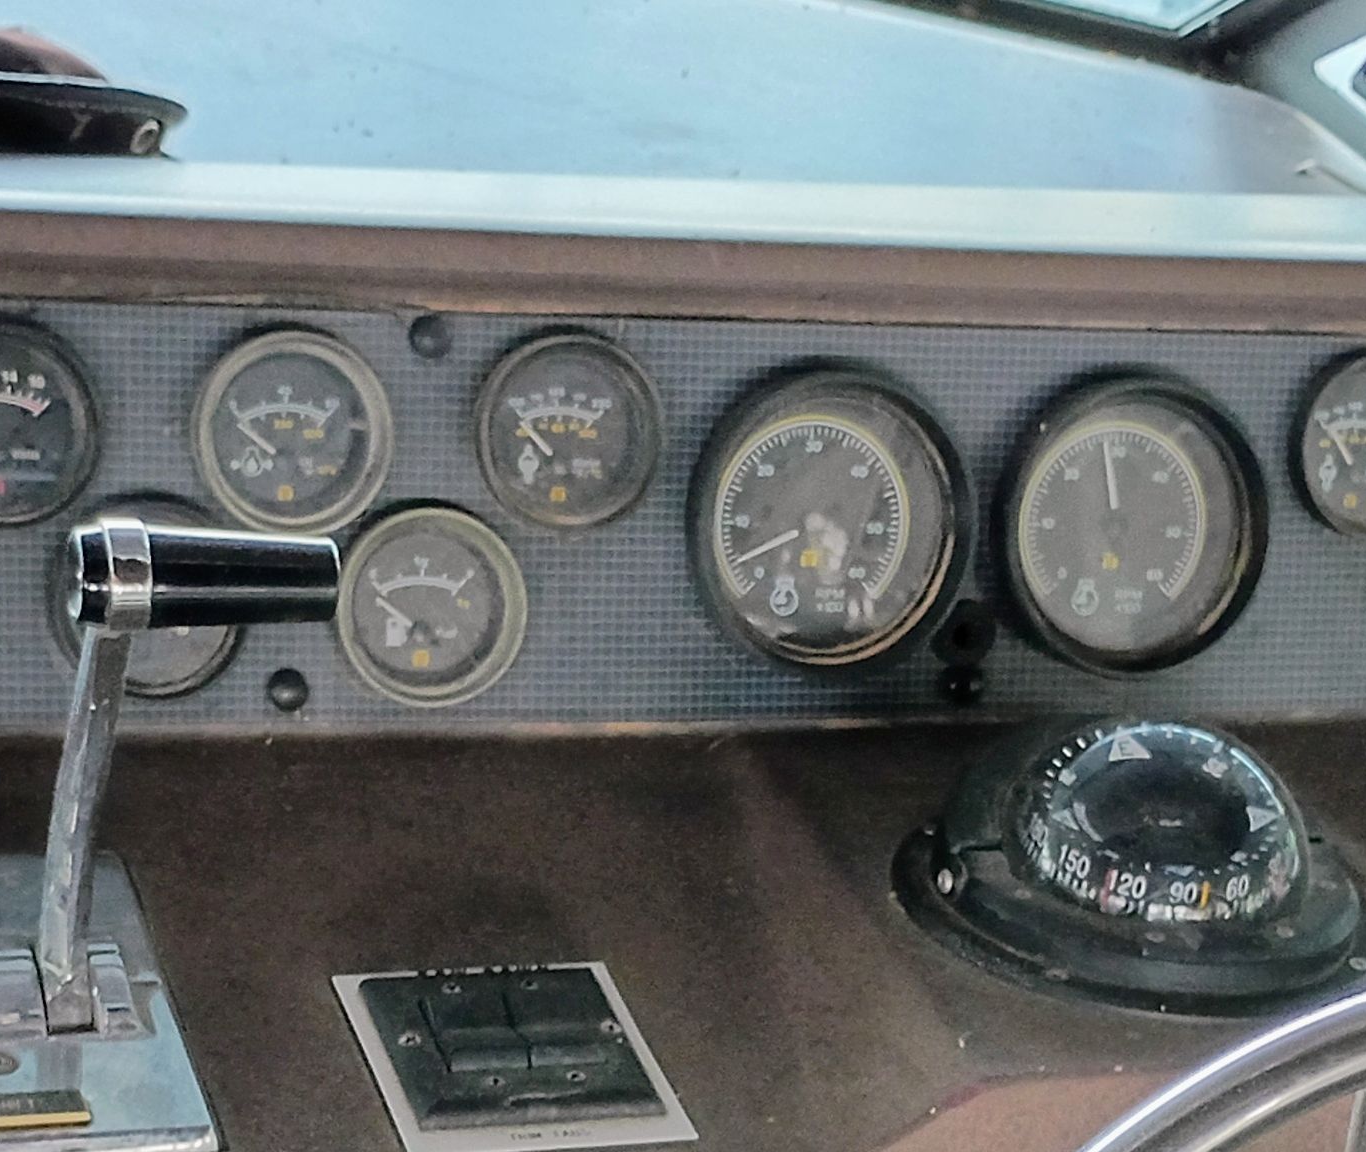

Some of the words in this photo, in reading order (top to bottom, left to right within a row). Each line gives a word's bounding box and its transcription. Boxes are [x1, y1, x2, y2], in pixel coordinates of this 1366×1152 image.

[805, 440, 823, 453] 30
[757, 464, 775, 477] 20
[850, 465, 869, 478] 40
[866, 522, 884, 535] 50
[847, 567, 865, 580] 60
[1118, 740, 1134, 757] E
[1059, 844, 1091, 880] 150
[1108, 868, 1148, 899] 120
[1169, 881, 1198, 904] 90
[1225, 874, 1251, 902] 60
